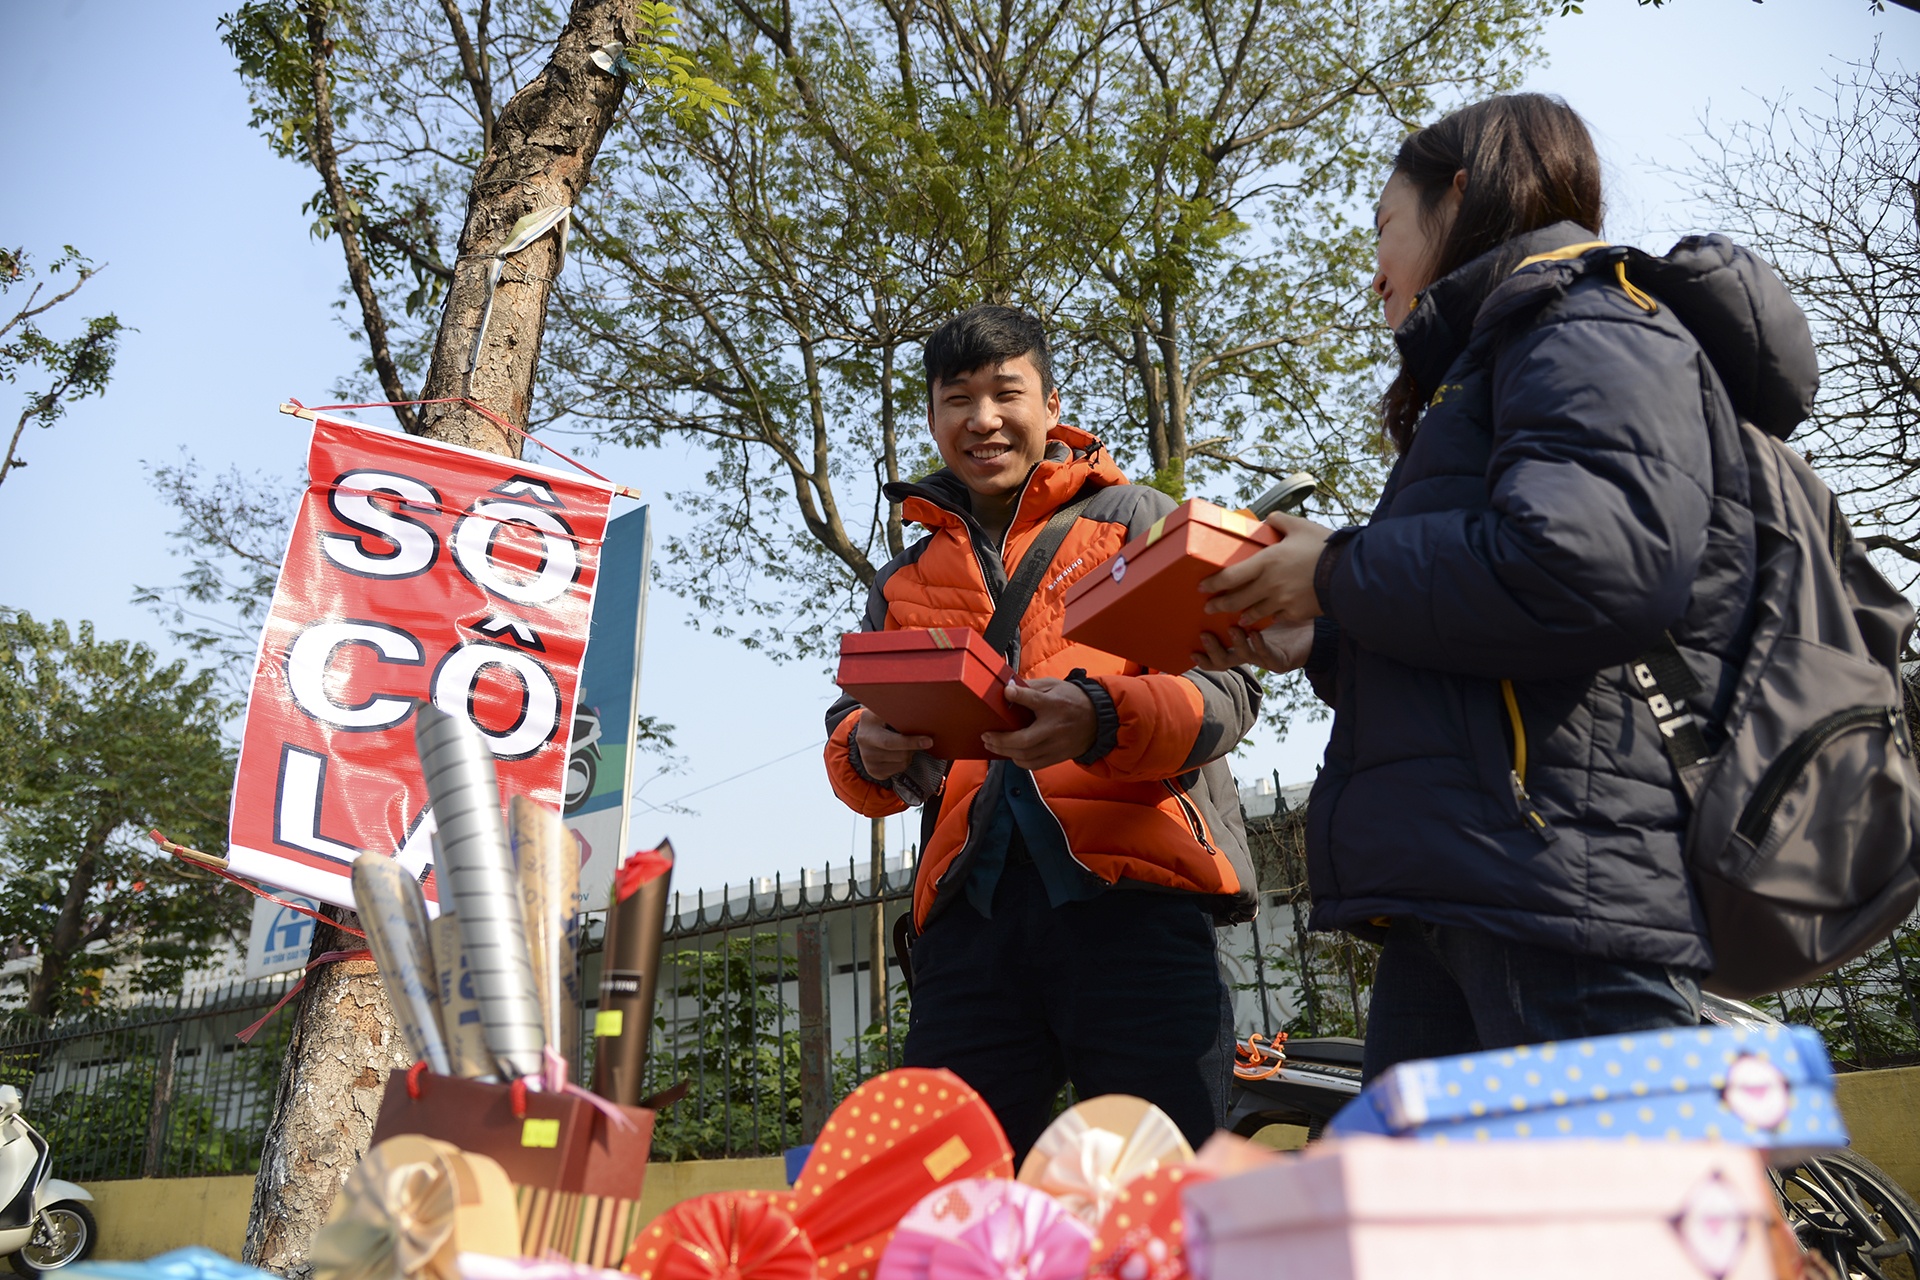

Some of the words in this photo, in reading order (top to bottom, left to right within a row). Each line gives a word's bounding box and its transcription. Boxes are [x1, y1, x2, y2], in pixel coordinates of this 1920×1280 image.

[319, 468, 582, 607] SÔ
[1048, 558, 1083, 591] SAMSUNG
[285, 614, 563, 762] CÔ
